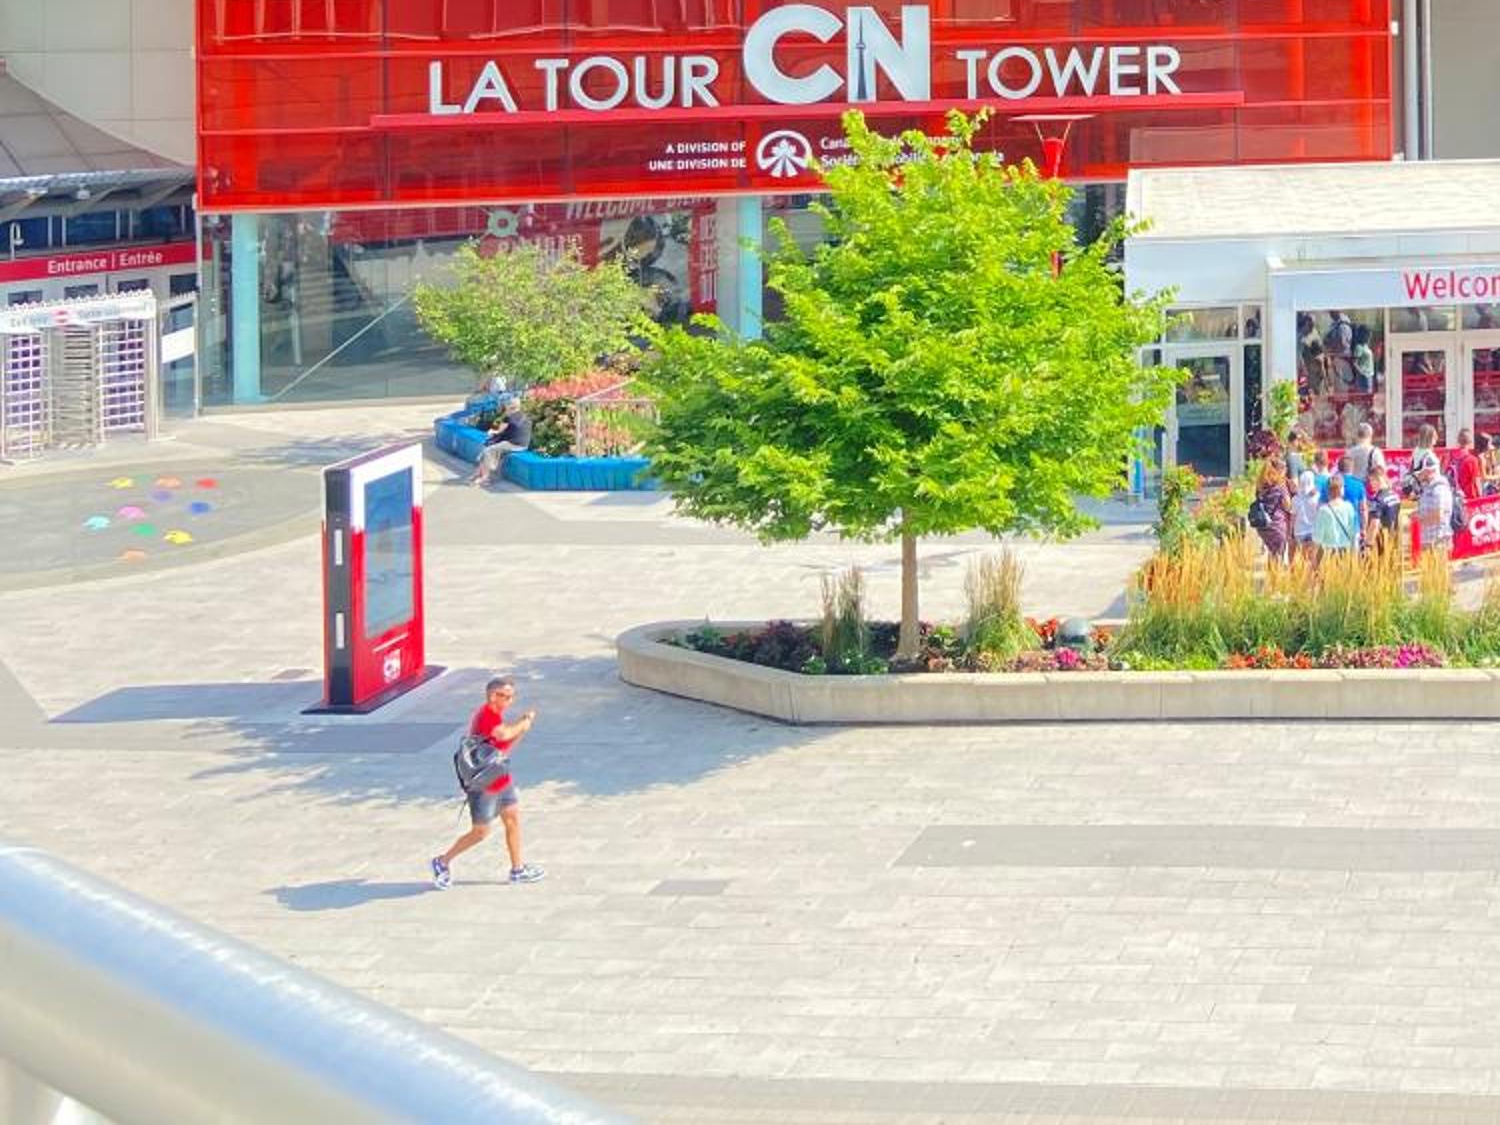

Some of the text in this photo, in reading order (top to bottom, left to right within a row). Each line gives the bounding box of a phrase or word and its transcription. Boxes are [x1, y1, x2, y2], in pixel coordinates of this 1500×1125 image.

[430, 4, 1183, 114] LA TOUR CN TOWER
[666, 141, 746, 154] A DIVISION OF
[650, 157, 746, 171] UNE DIVISION DE
[48, 251, 163, 274] Entrance Entrée
[1470, 510, 1500, 537] CN
